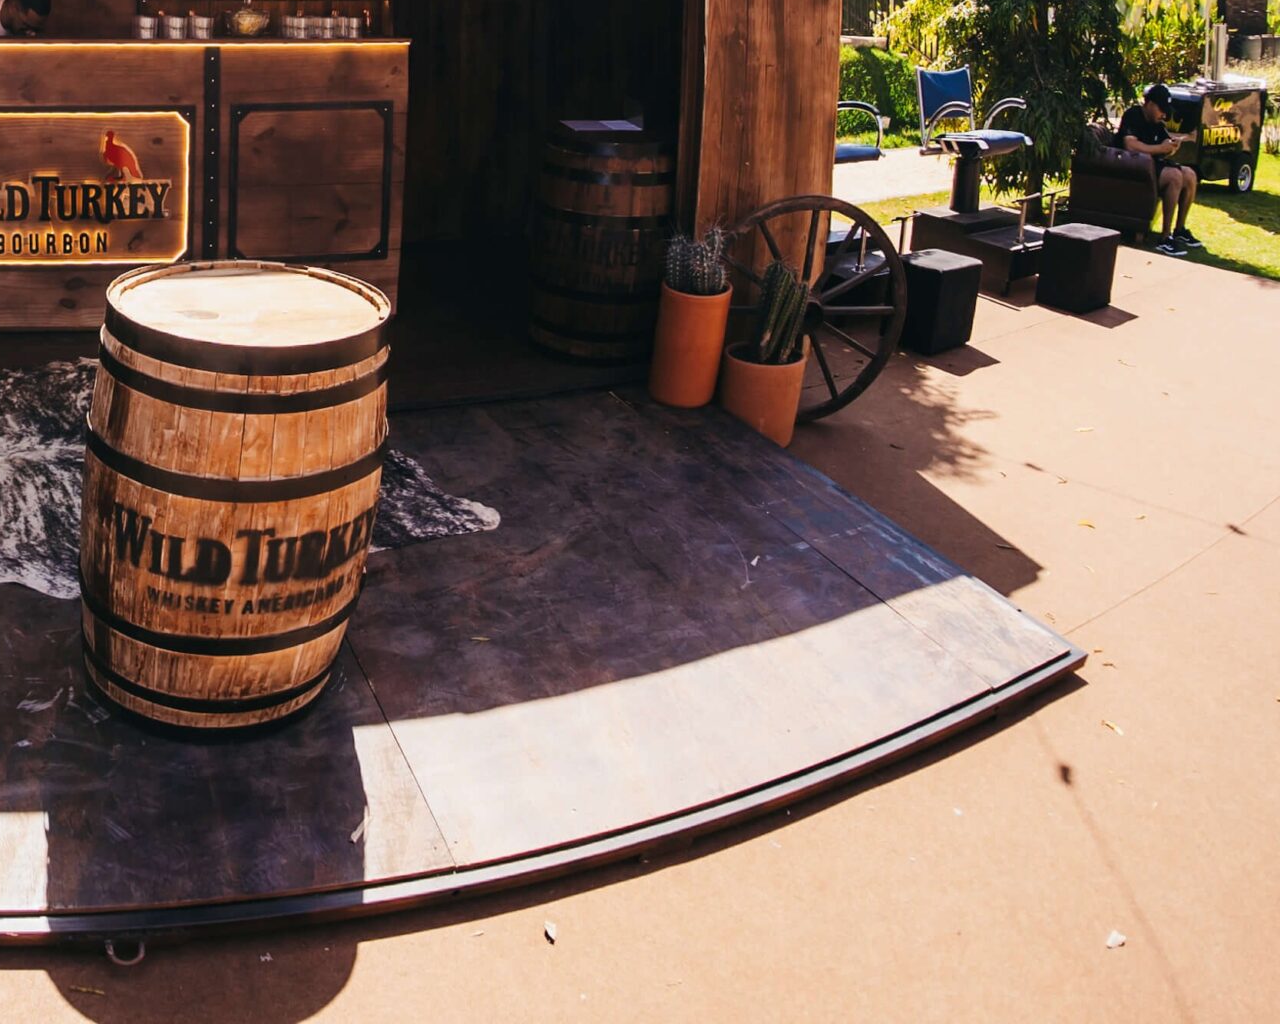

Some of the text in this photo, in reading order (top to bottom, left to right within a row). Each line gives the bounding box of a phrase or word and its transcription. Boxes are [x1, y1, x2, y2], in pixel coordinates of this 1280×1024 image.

[31, 175, 171, 224] TURKEY
[113, 501, 232, 586] WILD
[147, 585, 235, 615] WHISKEY
